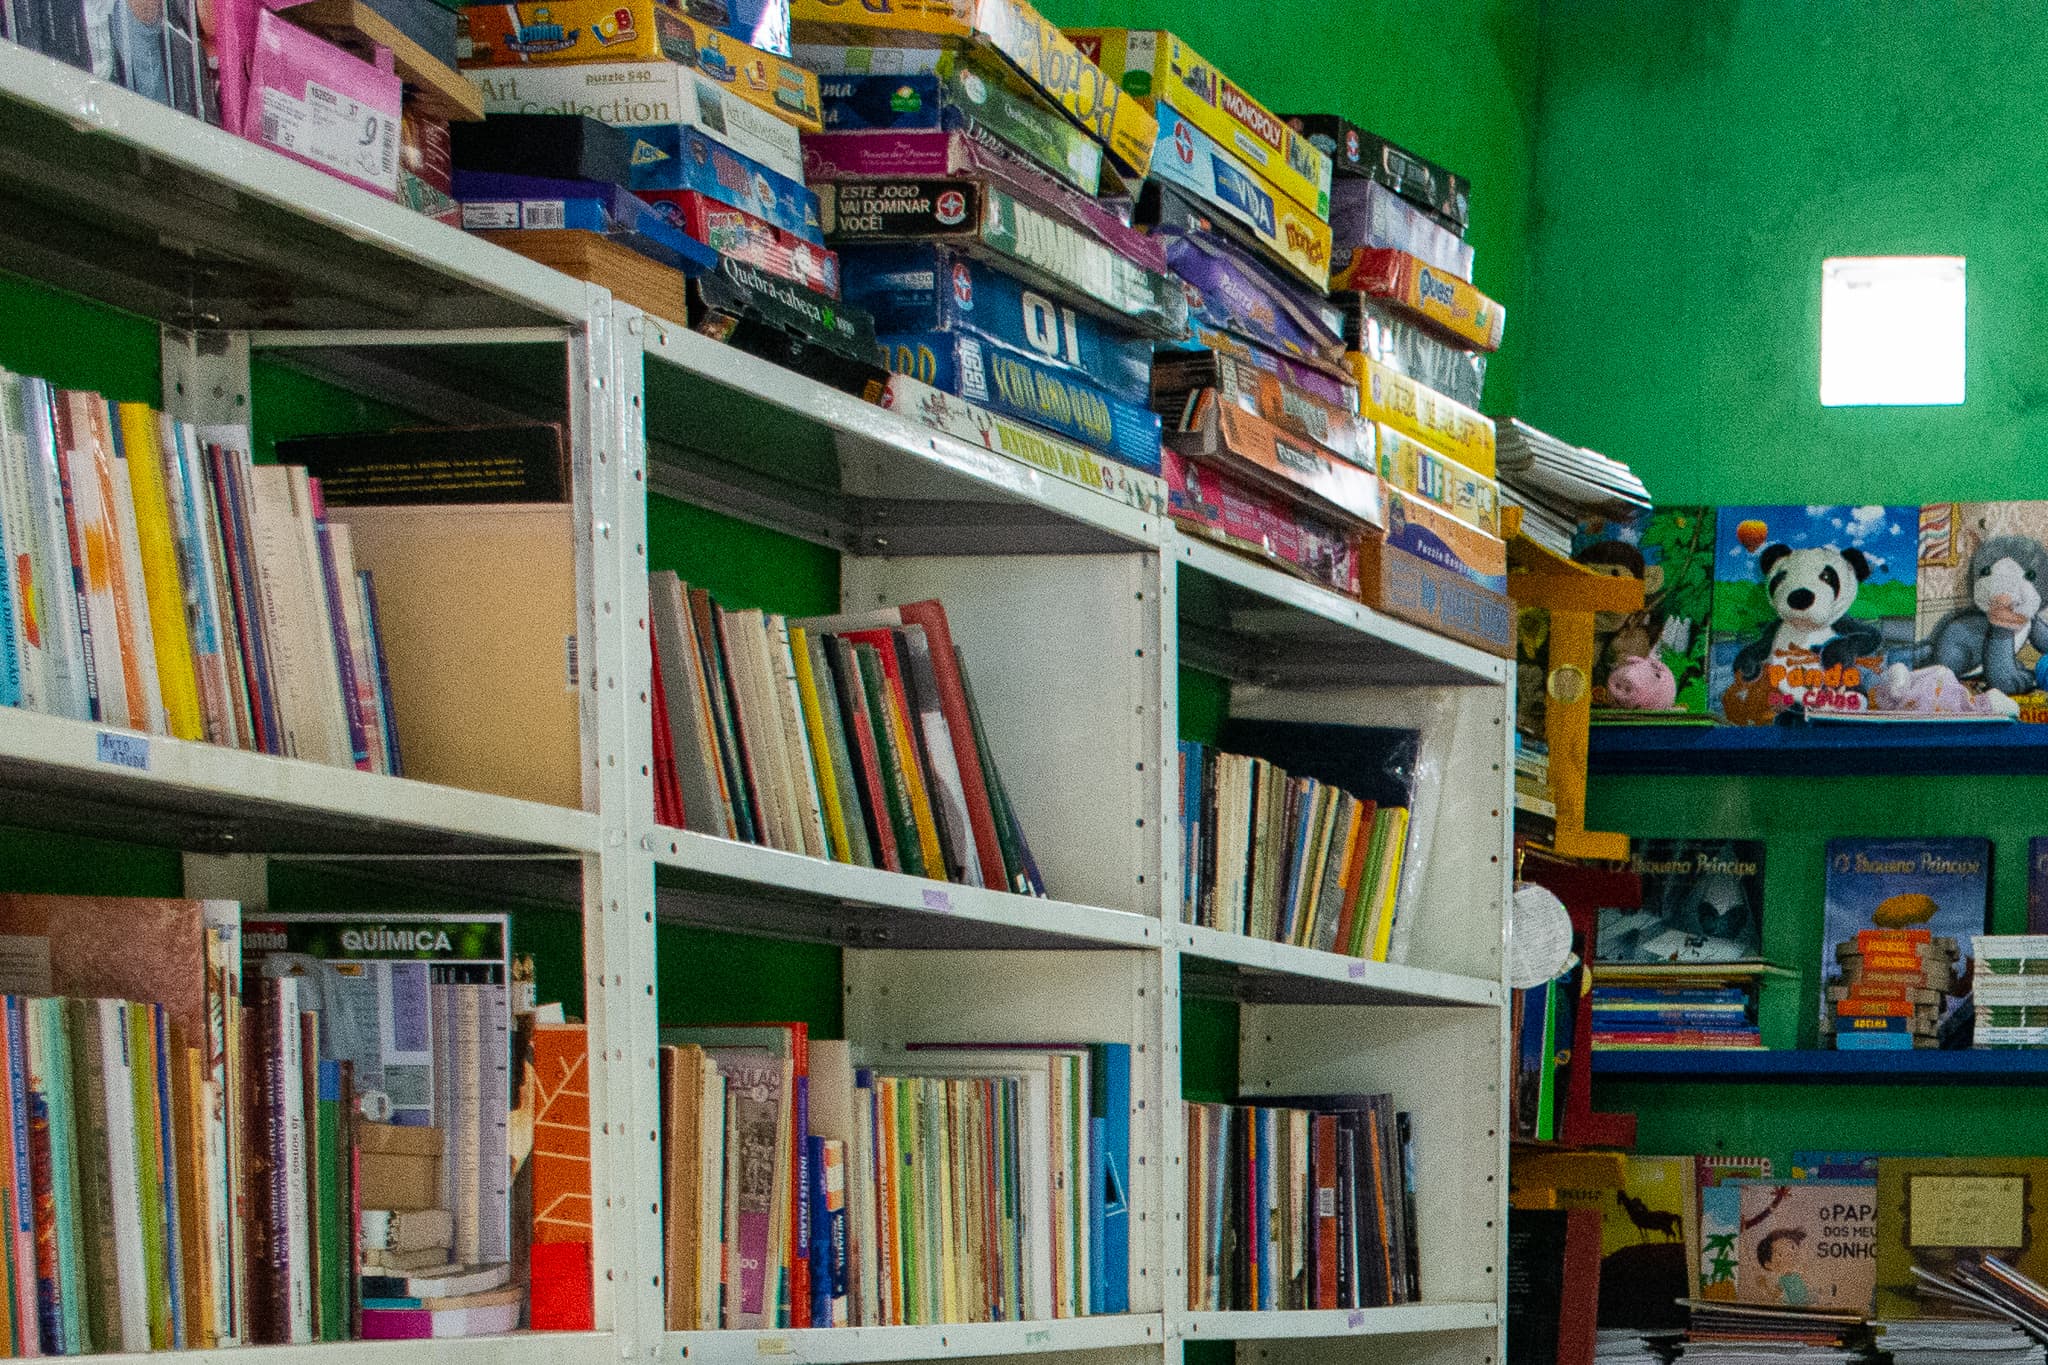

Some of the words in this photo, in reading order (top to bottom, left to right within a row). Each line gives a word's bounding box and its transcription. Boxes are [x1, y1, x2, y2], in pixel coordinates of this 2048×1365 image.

[481, 76, 522, 101] Art
[1224, 90, 1282, 149] MONOPOLY
[840, 186, 877, 199] ESTE
[878, 185, 920, 199] JOGO
[840, 200, 861, 214] VAI
[863, 199, 931, 214] DOMINAR
[840, 214, 883, 231] VOCÊ!
[724, 255, 822, 323] Quebra-cabeça
[1022, 290, 1088, 368] QI
[1768, 663, 1861, 687] Panda
[1835, 853, 1851, 873] O
[342, 924, 452, 951] QUÍMICA
[798, 1155, 809, 1198] INGLÊS
[798, 1201, 809, 1248] FALADO
[1819, 1206, 1830, 1221] O
[1833, 1204, 1878, 1221] PAPA
[1823, 1226, 1849, 1238] DOS
[1853, 1226, 1878, 1239] MEU
[1816, 1241, 1878, 1259] SONHO
